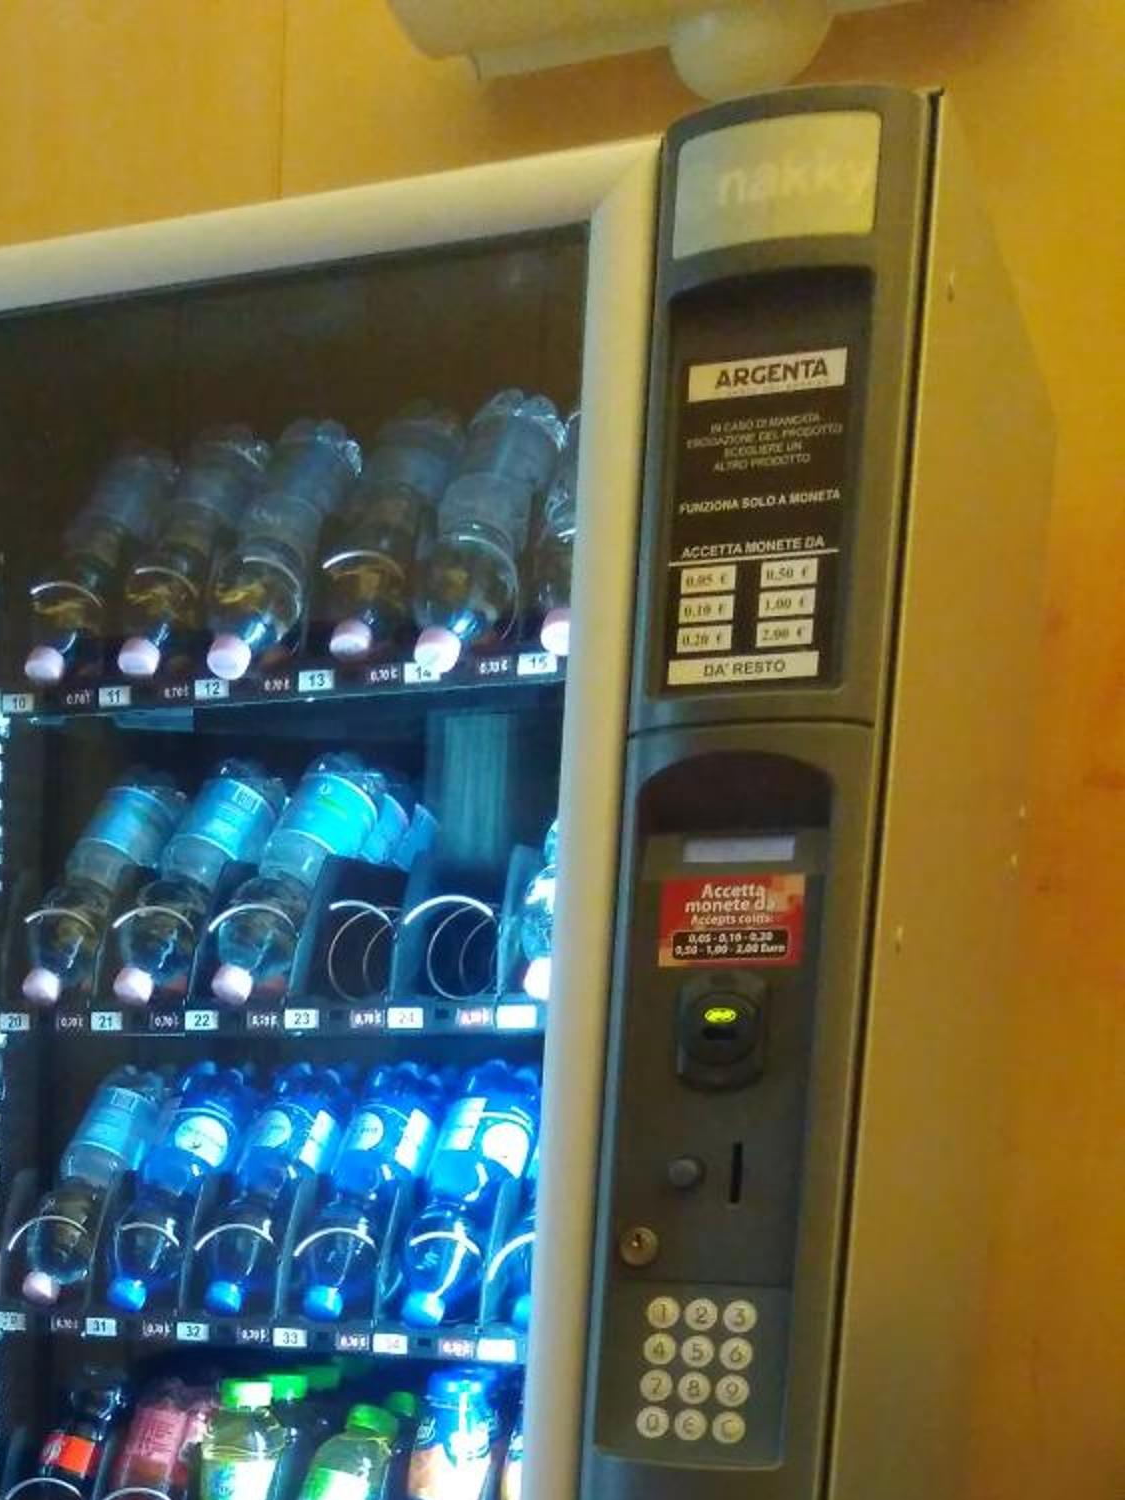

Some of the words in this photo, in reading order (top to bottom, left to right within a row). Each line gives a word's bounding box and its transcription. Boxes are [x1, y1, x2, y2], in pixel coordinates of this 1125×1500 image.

[715, 358, 828, 389] ARGENTA
[679, 500, 740, 515] FUNZIONA
[741, 495, 776, 509] SOLO
[788, 487, 841, 504] MONETA
[681, 543, 743, 560] ACCETTA
[744, 537, 802, 554] MONETE
[803, 534, 825, 549] DA
[732, 658, 786, 676] RESTO
[204, 681, 220, 695] 12
[309, 672, 326, 688] 13
[701, 883, 766, 899] Accetta
[684, 898, 751, 913] monete
[690, 914, 737, 926] Accepts
[760, 943, 787, 954] Euro
[99, 1015, 112, 1028] 21
[194, 1013, 211, 1027] 22
[294, 1012, 310, 1025] 23
[695, 1305, 709, 1324] 2
[733, 1307, 746, 1327] 3
[186, 1325, 200, 1337] 32
[283, 1332, 298, 1345] 33
[651, 1341, 665, 1360] 4
[690, 1342, 704, 1361] 5
[729, 1344, 743, 1364] 6
[649, 1377, 663, 1395] 7
[687, 1379, 701, 1398] 8
[725, 1381, 740, 1401] 9
[645, 1413, 660, 1432] 0
